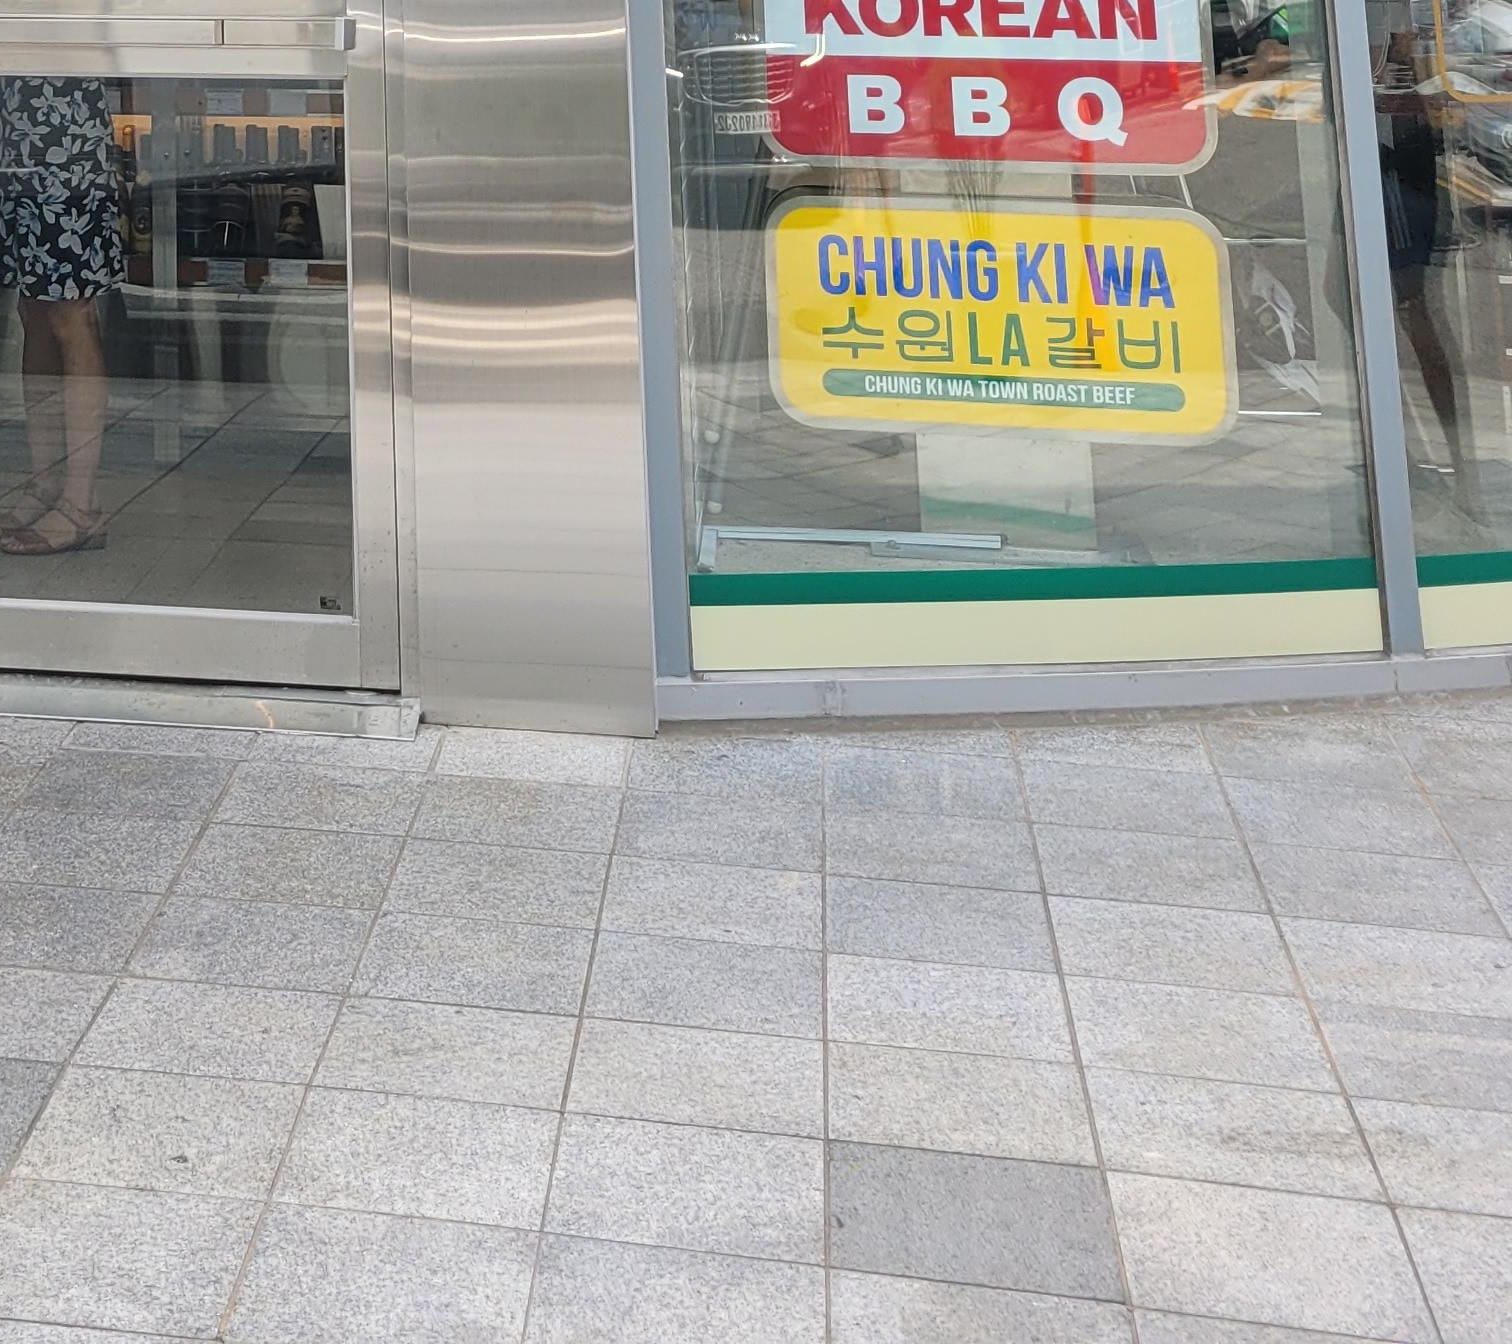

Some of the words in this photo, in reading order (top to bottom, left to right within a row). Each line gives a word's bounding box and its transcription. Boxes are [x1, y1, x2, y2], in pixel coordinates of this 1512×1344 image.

[819, 235, 1000, 300] CHUNG
[1016, 242, 1068, 304] KI
[1084, 244, 1176, 309] WA
[864, 375, 921, 394] CHUNG
[926, 378, 942, 396] KI
[948, 379, 974, 398] WA
[978, 380, 1028, 400] TOWN
[1032, 382, 1089, 403] ROAST
[1092, 385, 1136, 405] BEEF
